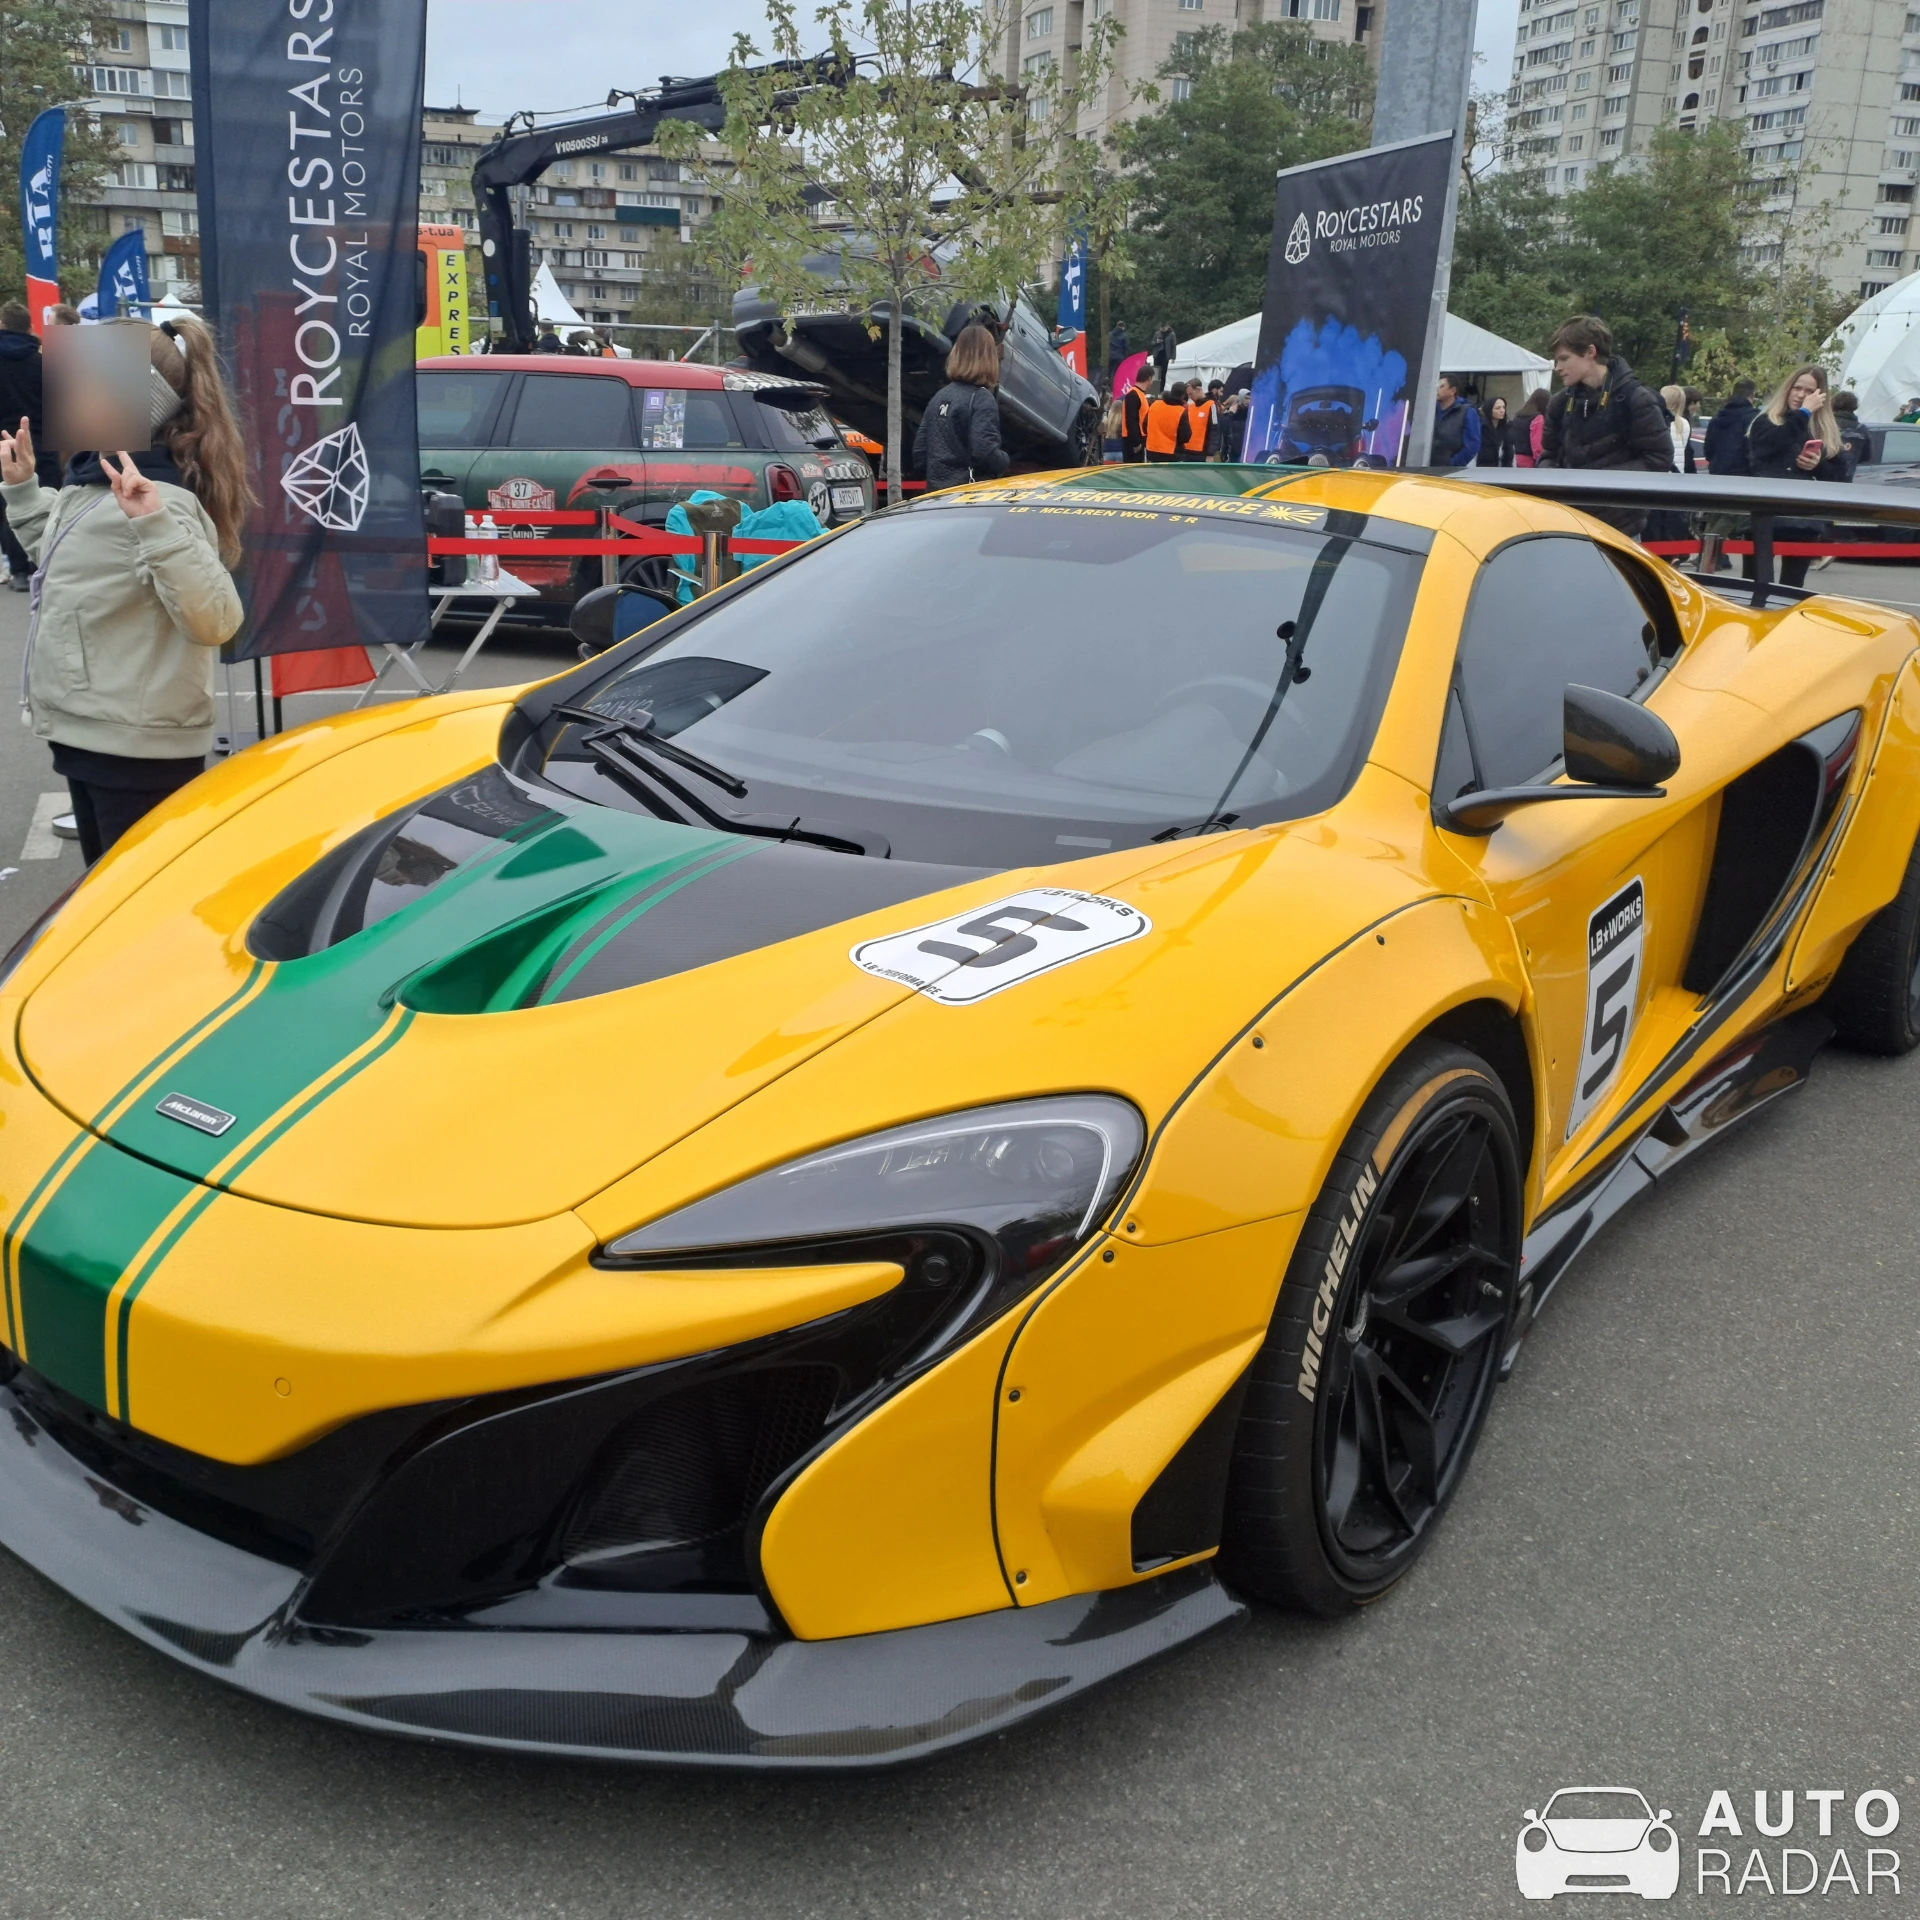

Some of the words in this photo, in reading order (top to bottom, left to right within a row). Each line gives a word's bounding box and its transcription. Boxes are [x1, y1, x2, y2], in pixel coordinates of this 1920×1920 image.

[338, 68, 367, 216] MOTORS
[287, 0, 343, 406] ROYCESTARS
[1315, 195, 1423, 240] ROYCESTARS
[1330, 239, 1357, 253] ROYAL
[1359, 229, 1401, 249] MOTORS
[345, 231, 371, 336] ROYAL
[514, 482, 528, 498] 37
[811, 488, 827, 516] 37
[1008, 506, 1030, 514] LB
[1039, 507, 1118, 518] MCLAREN
[1053, 491, 1264, 516] PERFORMANCE
[513, 530, 533, 539] MINI
[917, 906, 1090, 968] 5
[1590, 927, 1603, 957] LB
[1608, 895, 1643, 941] WORKS
[1582, 953, 1636, 1101] 5
[164, 1100, 218, 1126] McLaren
[1297, 1162, 1378, 1404] MICHELIN
